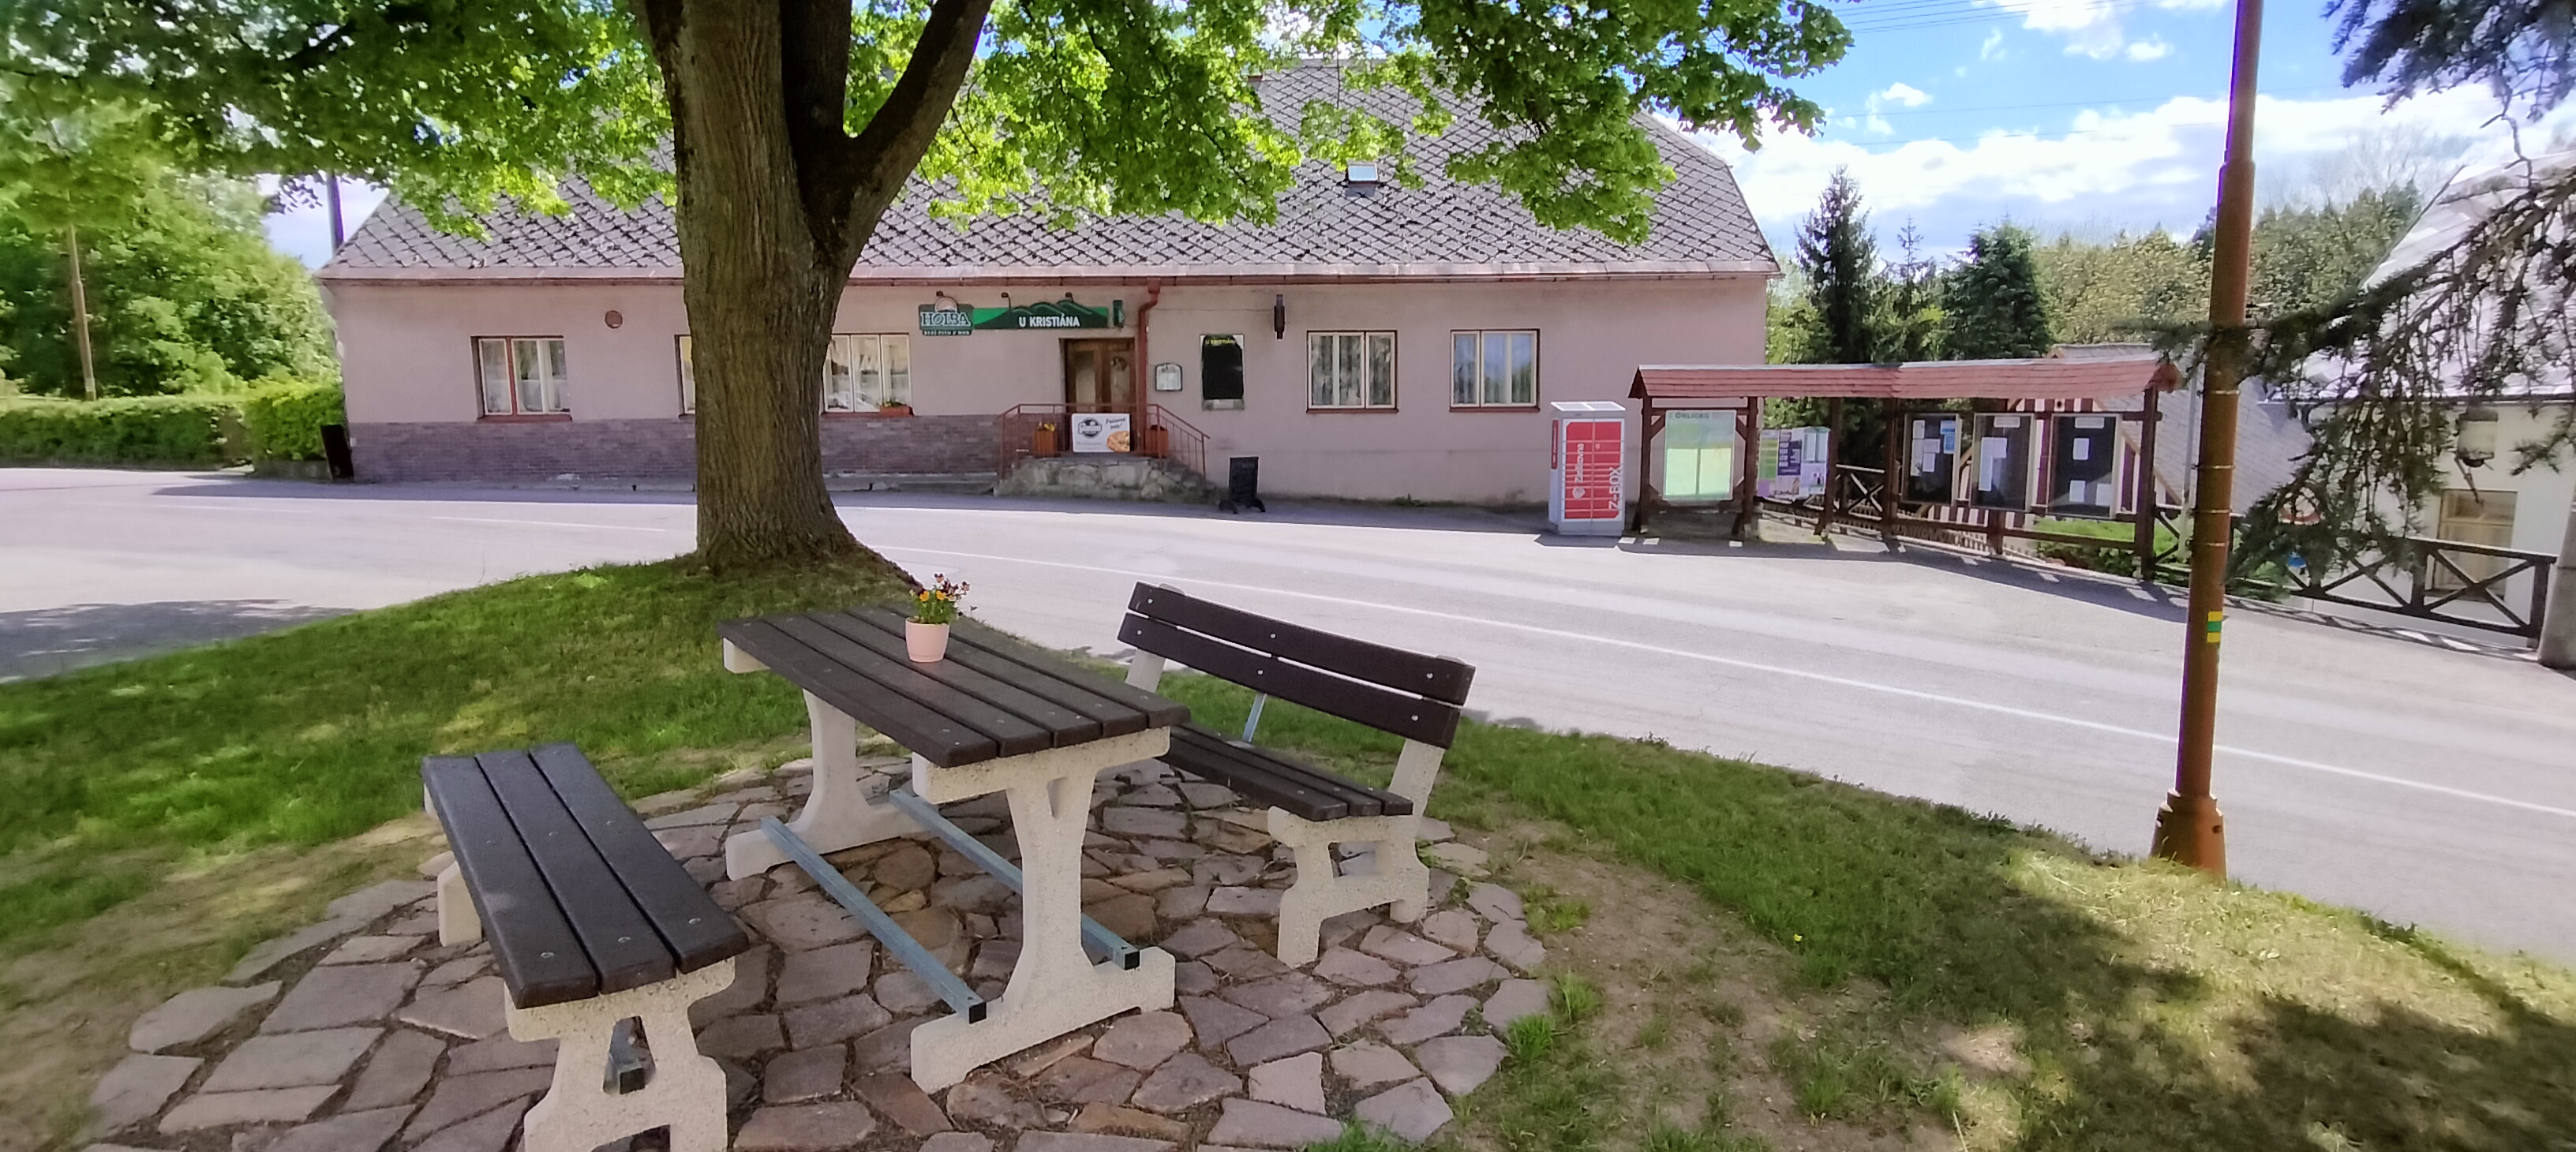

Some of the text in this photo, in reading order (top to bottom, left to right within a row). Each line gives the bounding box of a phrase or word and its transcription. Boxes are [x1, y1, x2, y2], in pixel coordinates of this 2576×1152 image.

[920, 312, 972, 326] HOLBA
[1018, 313, 1080, 327] U KRISTIÁNA
[1608, 466, 1621, 510] Z-BOX
